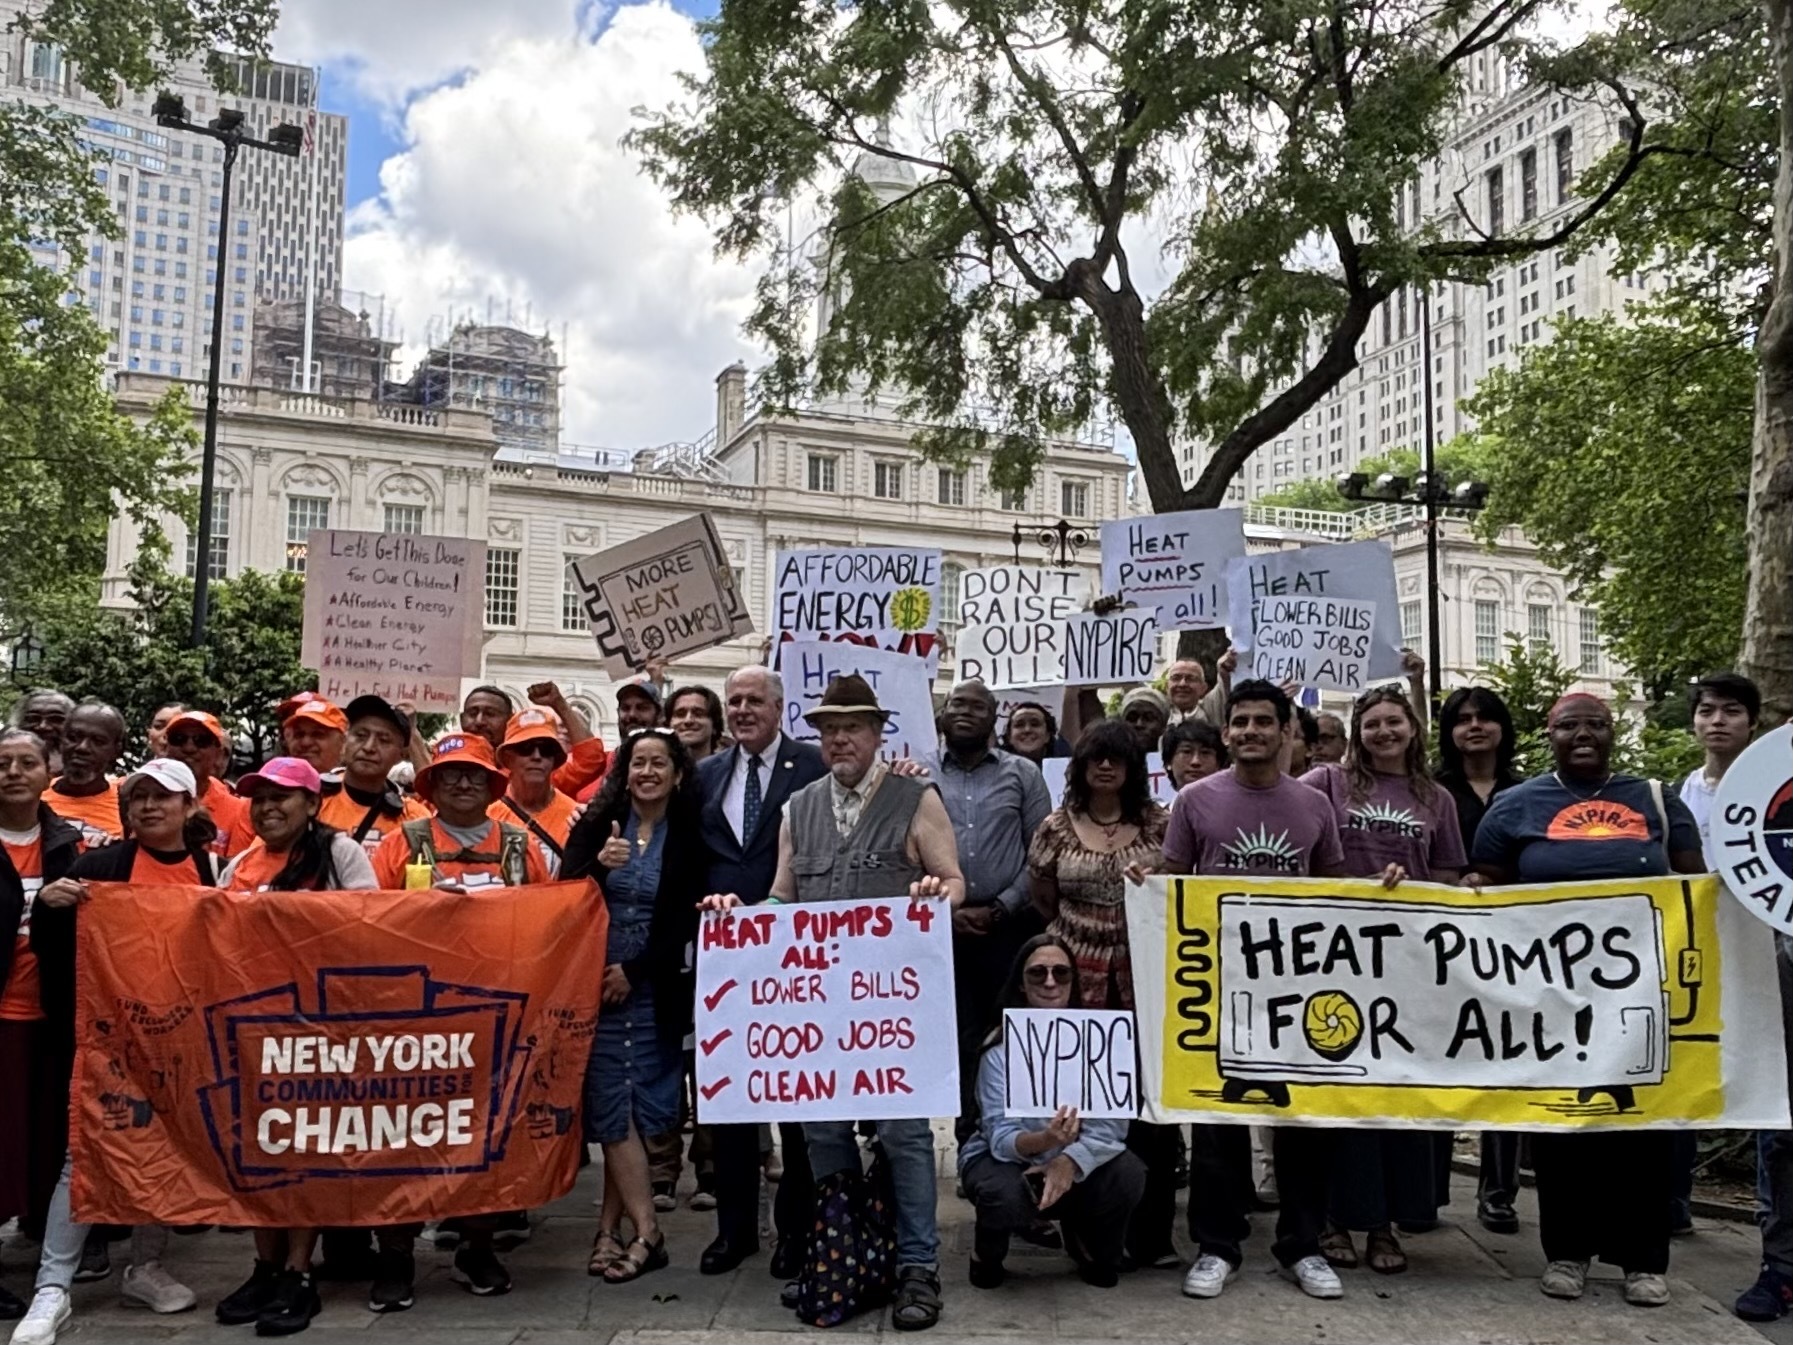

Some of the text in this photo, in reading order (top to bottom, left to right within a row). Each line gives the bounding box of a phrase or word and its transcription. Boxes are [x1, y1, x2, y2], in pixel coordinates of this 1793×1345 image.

[330, 532, 465, 567] Let's Get This Done
[1129, 524, 1190, 557] HEAT
[373, 569, 399, 585] Our
[403, 569, 459, 593] Children!
[625, 554, 694, 593] MORE
[779, 554, 938, 588] AFFORDABLE
[965, 568, 1080, 600] DON'T
[1120, 562, 1204, 585] PUMPS
[1249, 564, 1330, 599] HEAT
[339, 592, 455, 617] Affordable Energy
[620, 583, 680, 624] HEAT
[779, 588, 892, 632] ENERGY
[961, 596, 1076, 625] RAISE
[1175, 584, 1217, 617] all!
[1260, 599, 1322, 625] LOWER
[1325, 603, 1372, 631] BILLS
[336, 613, 425, 634] Clean Energy
[983, 623, 1057, 656] OUR
[392, 638, 427, 655] City
[1065, 617, 1155, 680] NYPIRG
[1257, 625, 1370, 659] GOOD JOBS
[389, 658, 433, 673] Planet
[1257, 652, 1360, 689] CLEAN AIR
[1349, 815, 1424, 839] NYPIRG
[1224, 852, 1300, 871] NYPIRG
[703, 902, 935, 951] HEAT PUMPS 4
[781, 943, 840, 970] ALL:
[1240, 917, 1642, 990] HEAT PUMPS
[752, 966, 921, 1006] LOWER BILLS
[747, 1017, 916, 1059] GOOD JOBS
[1267, 988, 1593, 1062] FOR ALL!
[261, 1032, 475, 1074] NEW YORK
[1005, 1013, 1133, 1111] NYPIRG
[258, 1074, 457, 1102] COMMUNITIES
[748, 1067, 914, 1104] CLEAN AIR
[257, 1098, 475, 1155] CHANGE
